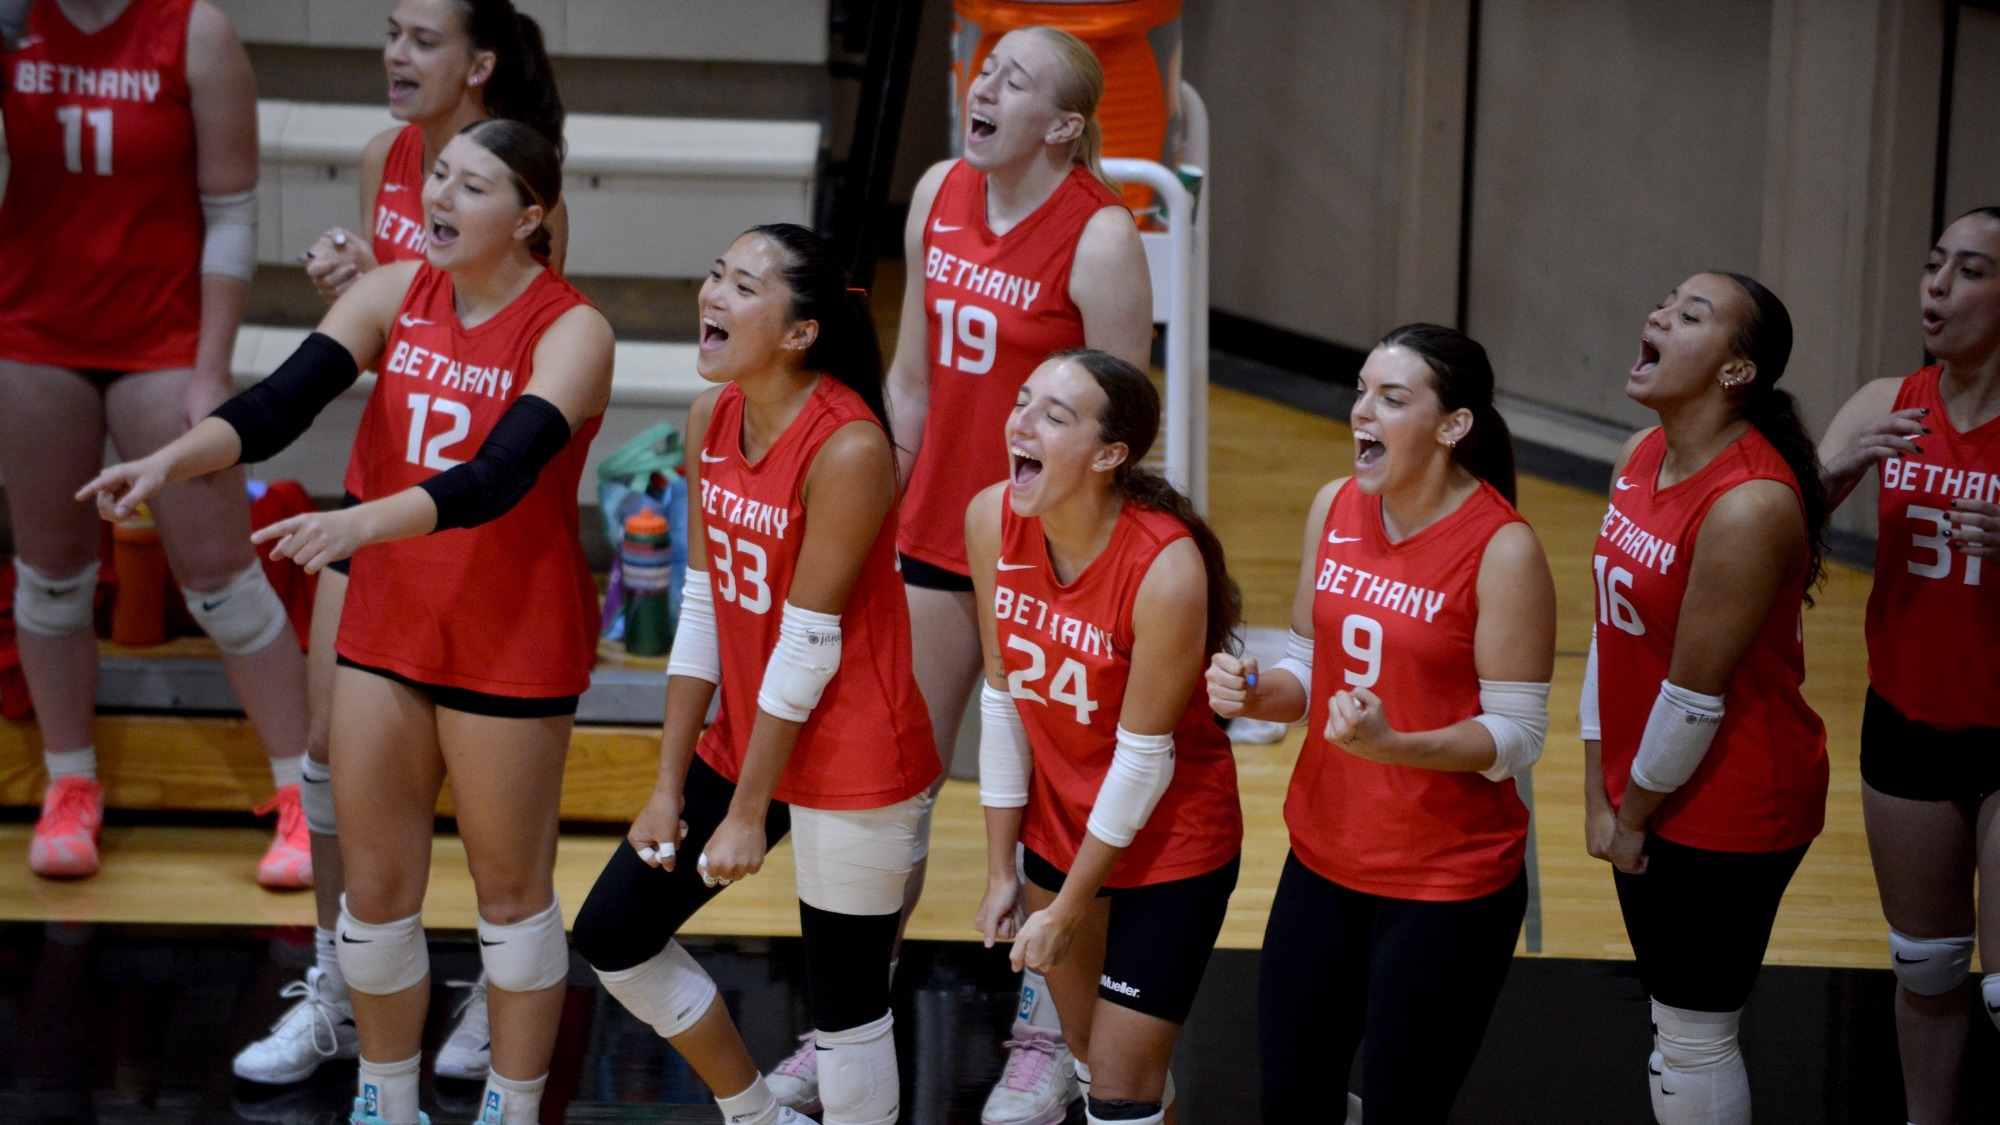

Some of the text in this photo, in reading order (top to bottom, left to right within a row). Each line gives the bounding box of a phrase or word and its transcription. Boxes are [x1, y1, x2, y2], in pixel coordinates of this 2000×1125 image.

[15, 60, 160, 103] BETHANY
[56, 105, 113, 176] 11
[926, 246, 1041, 311] BETHANY
[387, 340, 513, 401] BETHANY
[935, 298, 998, 375] 19
[406, 393, 471, 472] 12
[708, 525, 772, 615] 33
[1315, 557, 1446, 624] BETHANY
[1593, 554, 1646, 636] 16
[1007, 633, 1098, 725] 24
[1341, 613, 1383, 688] 9
